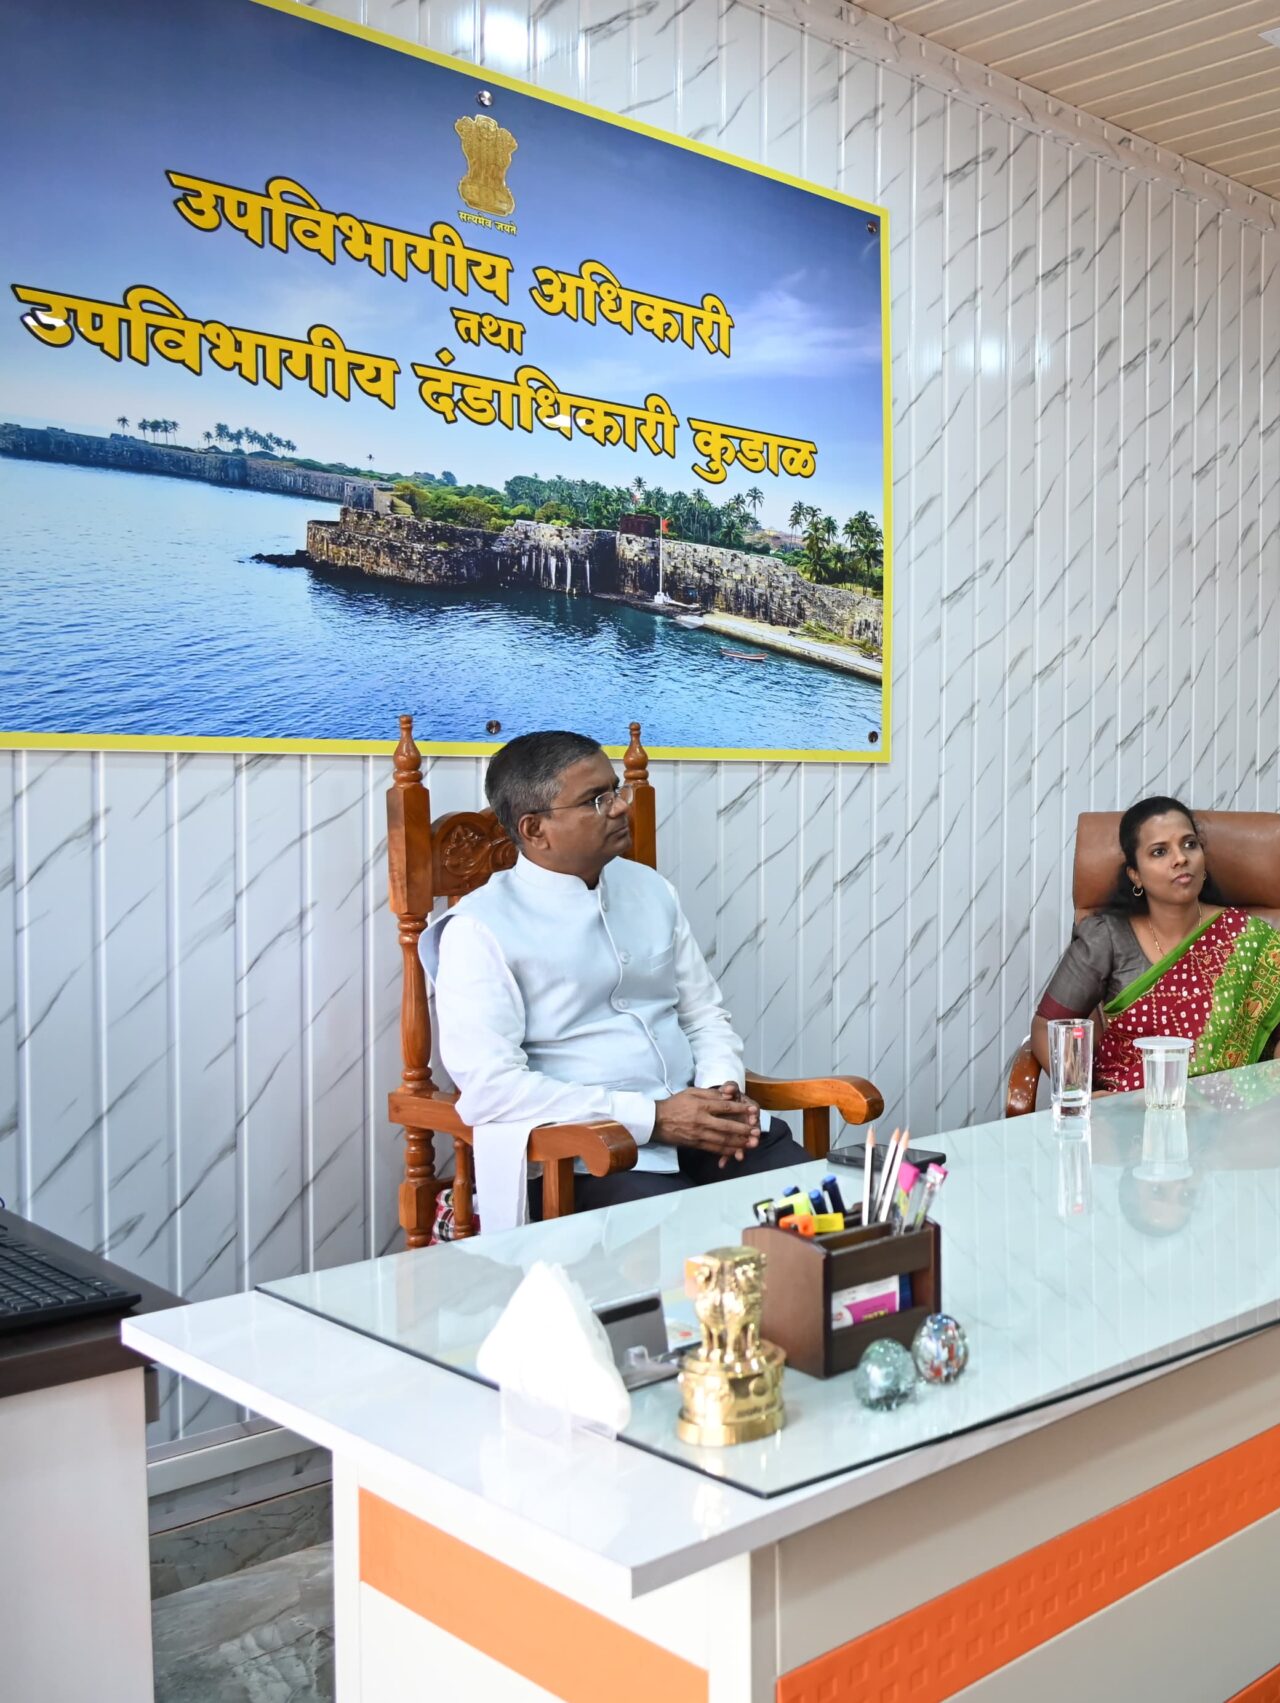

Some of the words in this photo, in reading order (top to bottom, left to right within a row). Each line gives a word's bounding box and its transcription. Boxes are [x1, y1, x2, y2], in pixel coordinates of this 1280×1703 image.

[165, 170, 514, 304] उपविभागीय
[529, 259, 734, 358] अधिकारी
[494, 220, 518, 236] जयते
[10, 283, 401, 409] उपविभागीय
[411, 347, 678, 458] दंडाधिकारी
[687, 417, 818, 485] कुडाळ
[450, 307, 526, 355] तथा
